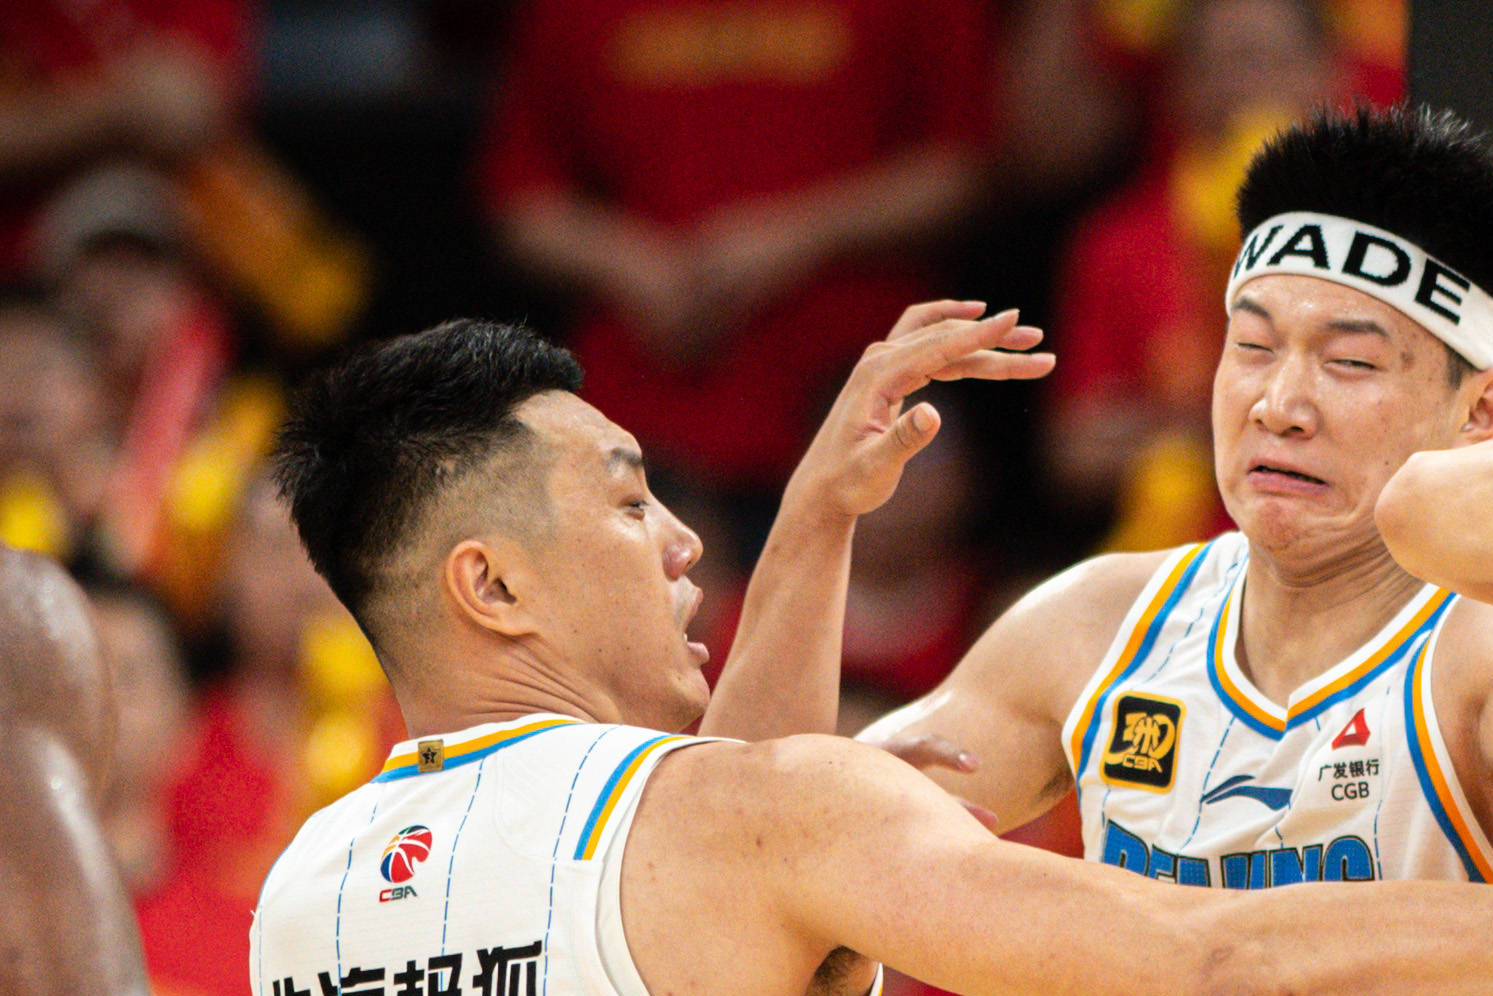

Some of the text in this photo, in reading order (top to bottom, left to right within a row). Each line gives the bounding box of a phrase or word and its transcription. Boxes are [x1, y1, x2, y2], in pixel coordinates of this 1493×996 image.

[1232, 223, 1471, 327] WADE
[1318, 758, 1379, 781] 广发银行
[1331, 781, 1370, 801] CGB
[379, 885, 418, 903] CBA
